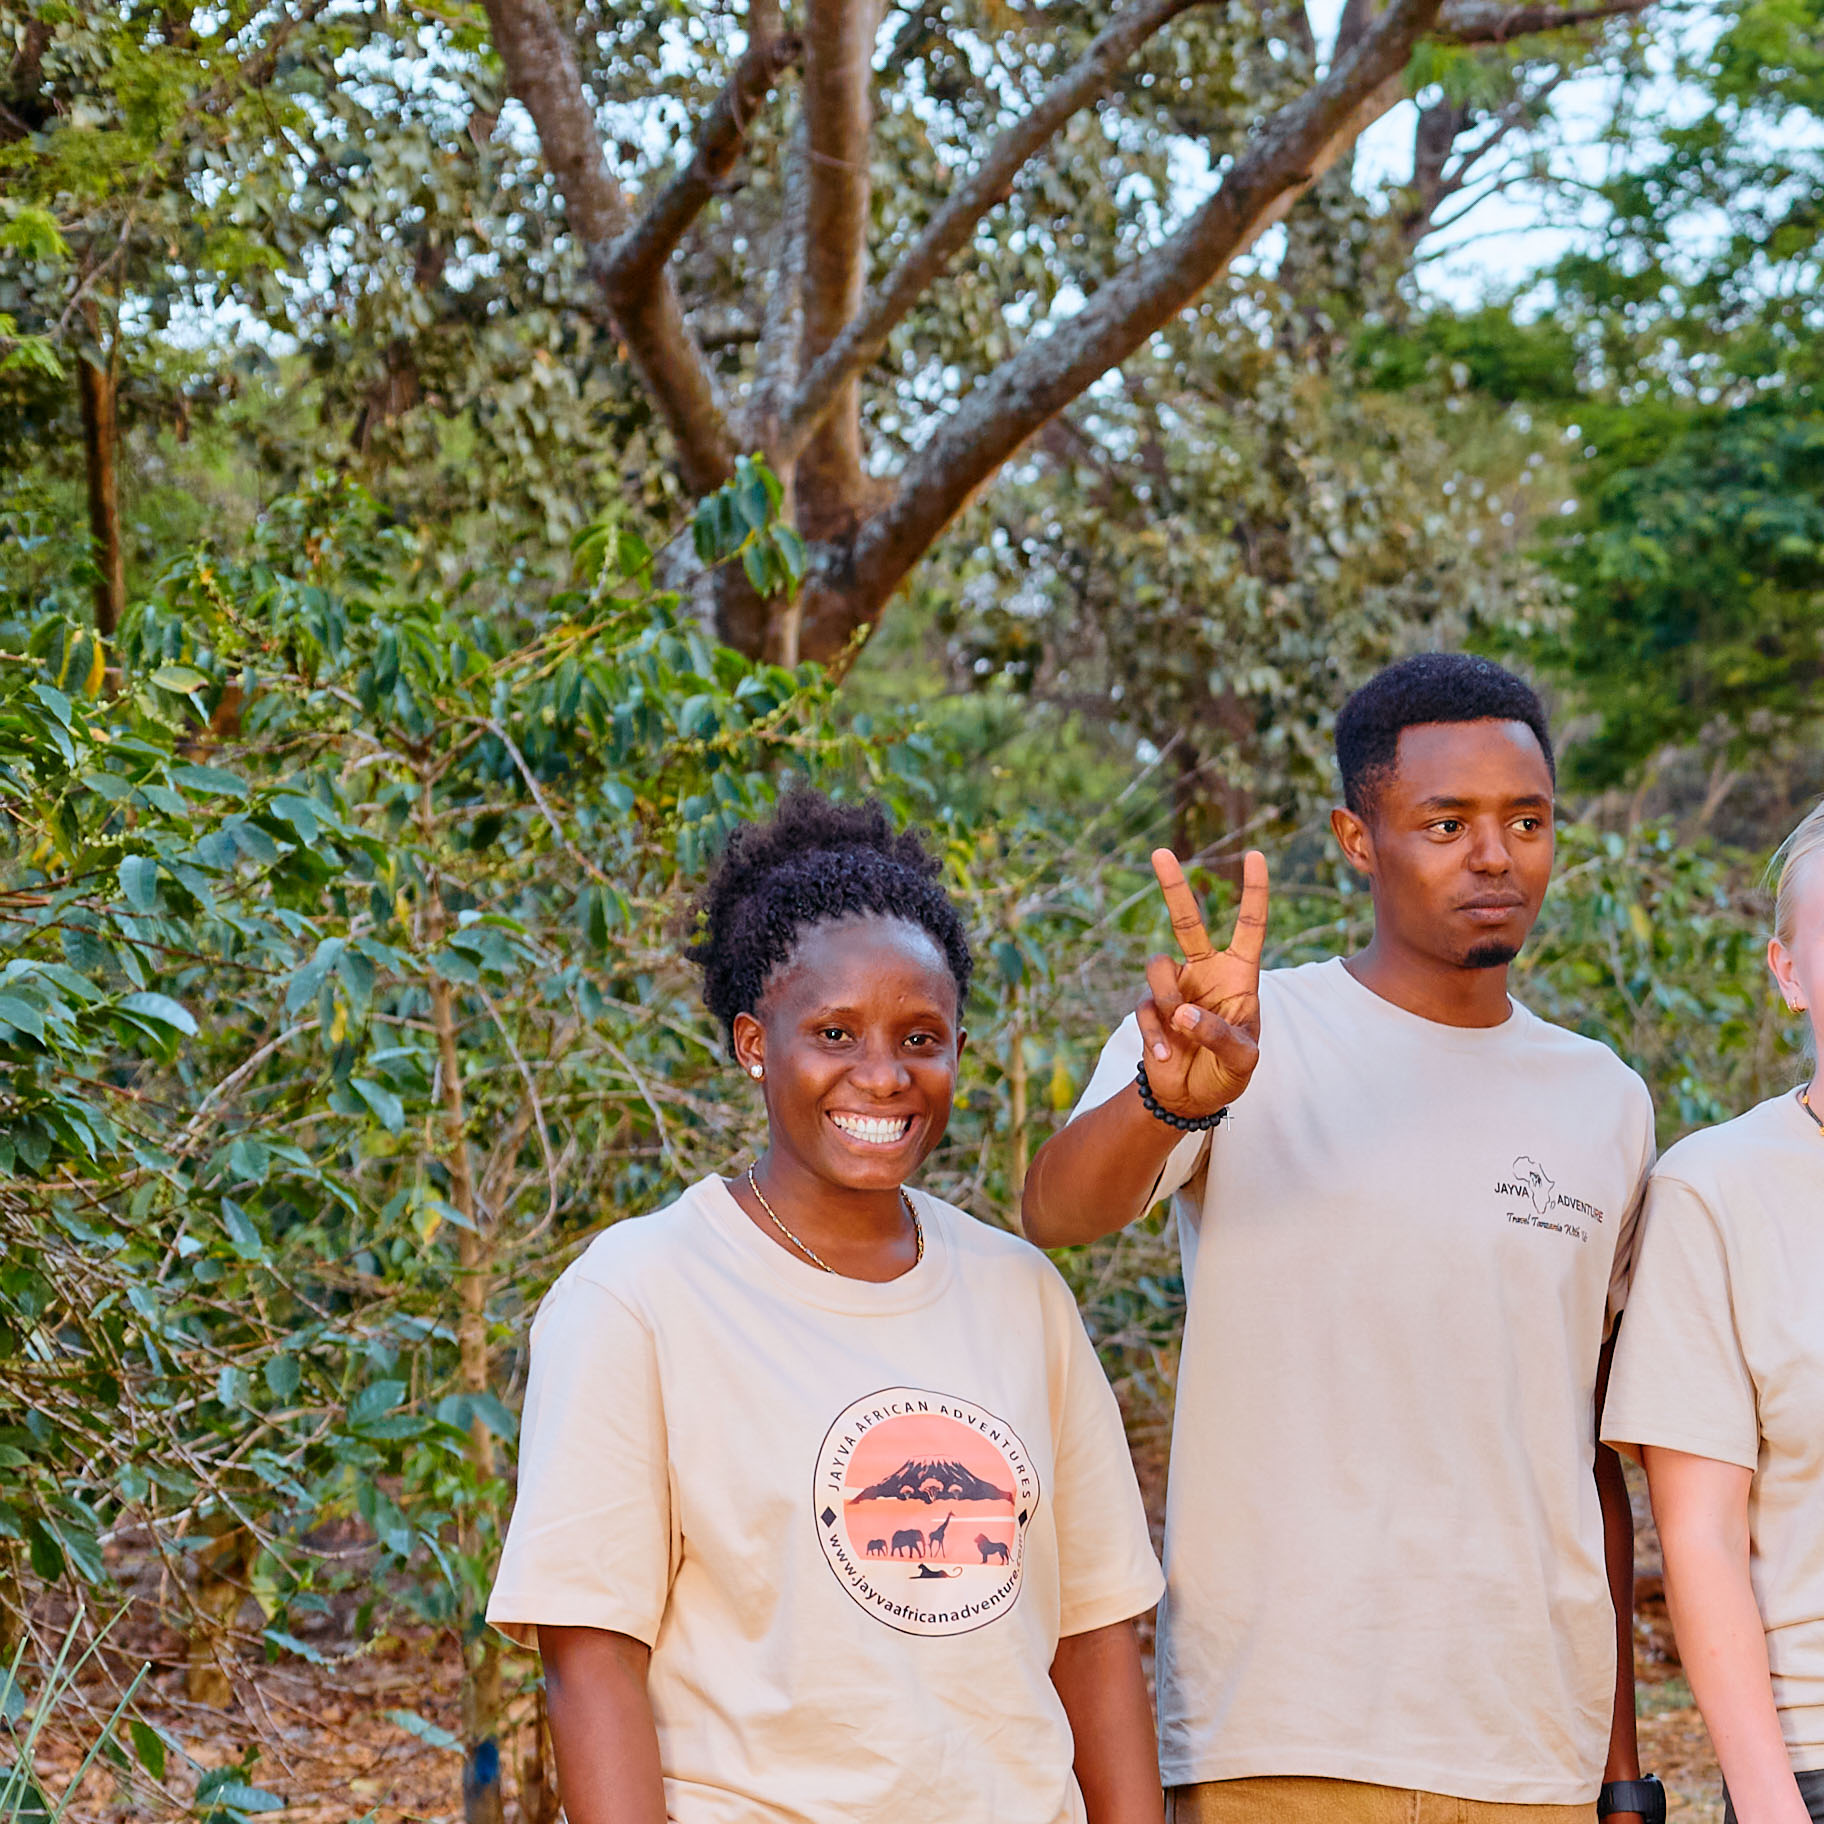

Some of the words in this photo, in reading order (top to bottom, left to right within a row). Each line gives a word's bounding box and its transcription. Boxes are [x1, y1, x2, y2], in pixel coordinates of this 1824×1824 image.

[1494, 1182, 1529, 1197] JAYVA
[1557, 1194, 1604, 1223] ADVENTURE
[828, 1436, 856, 1491] JAYVA
[855, 1401, 929, 1432] AFRICAN
[940, 1405, 1031, 1499] ADVENTURES
